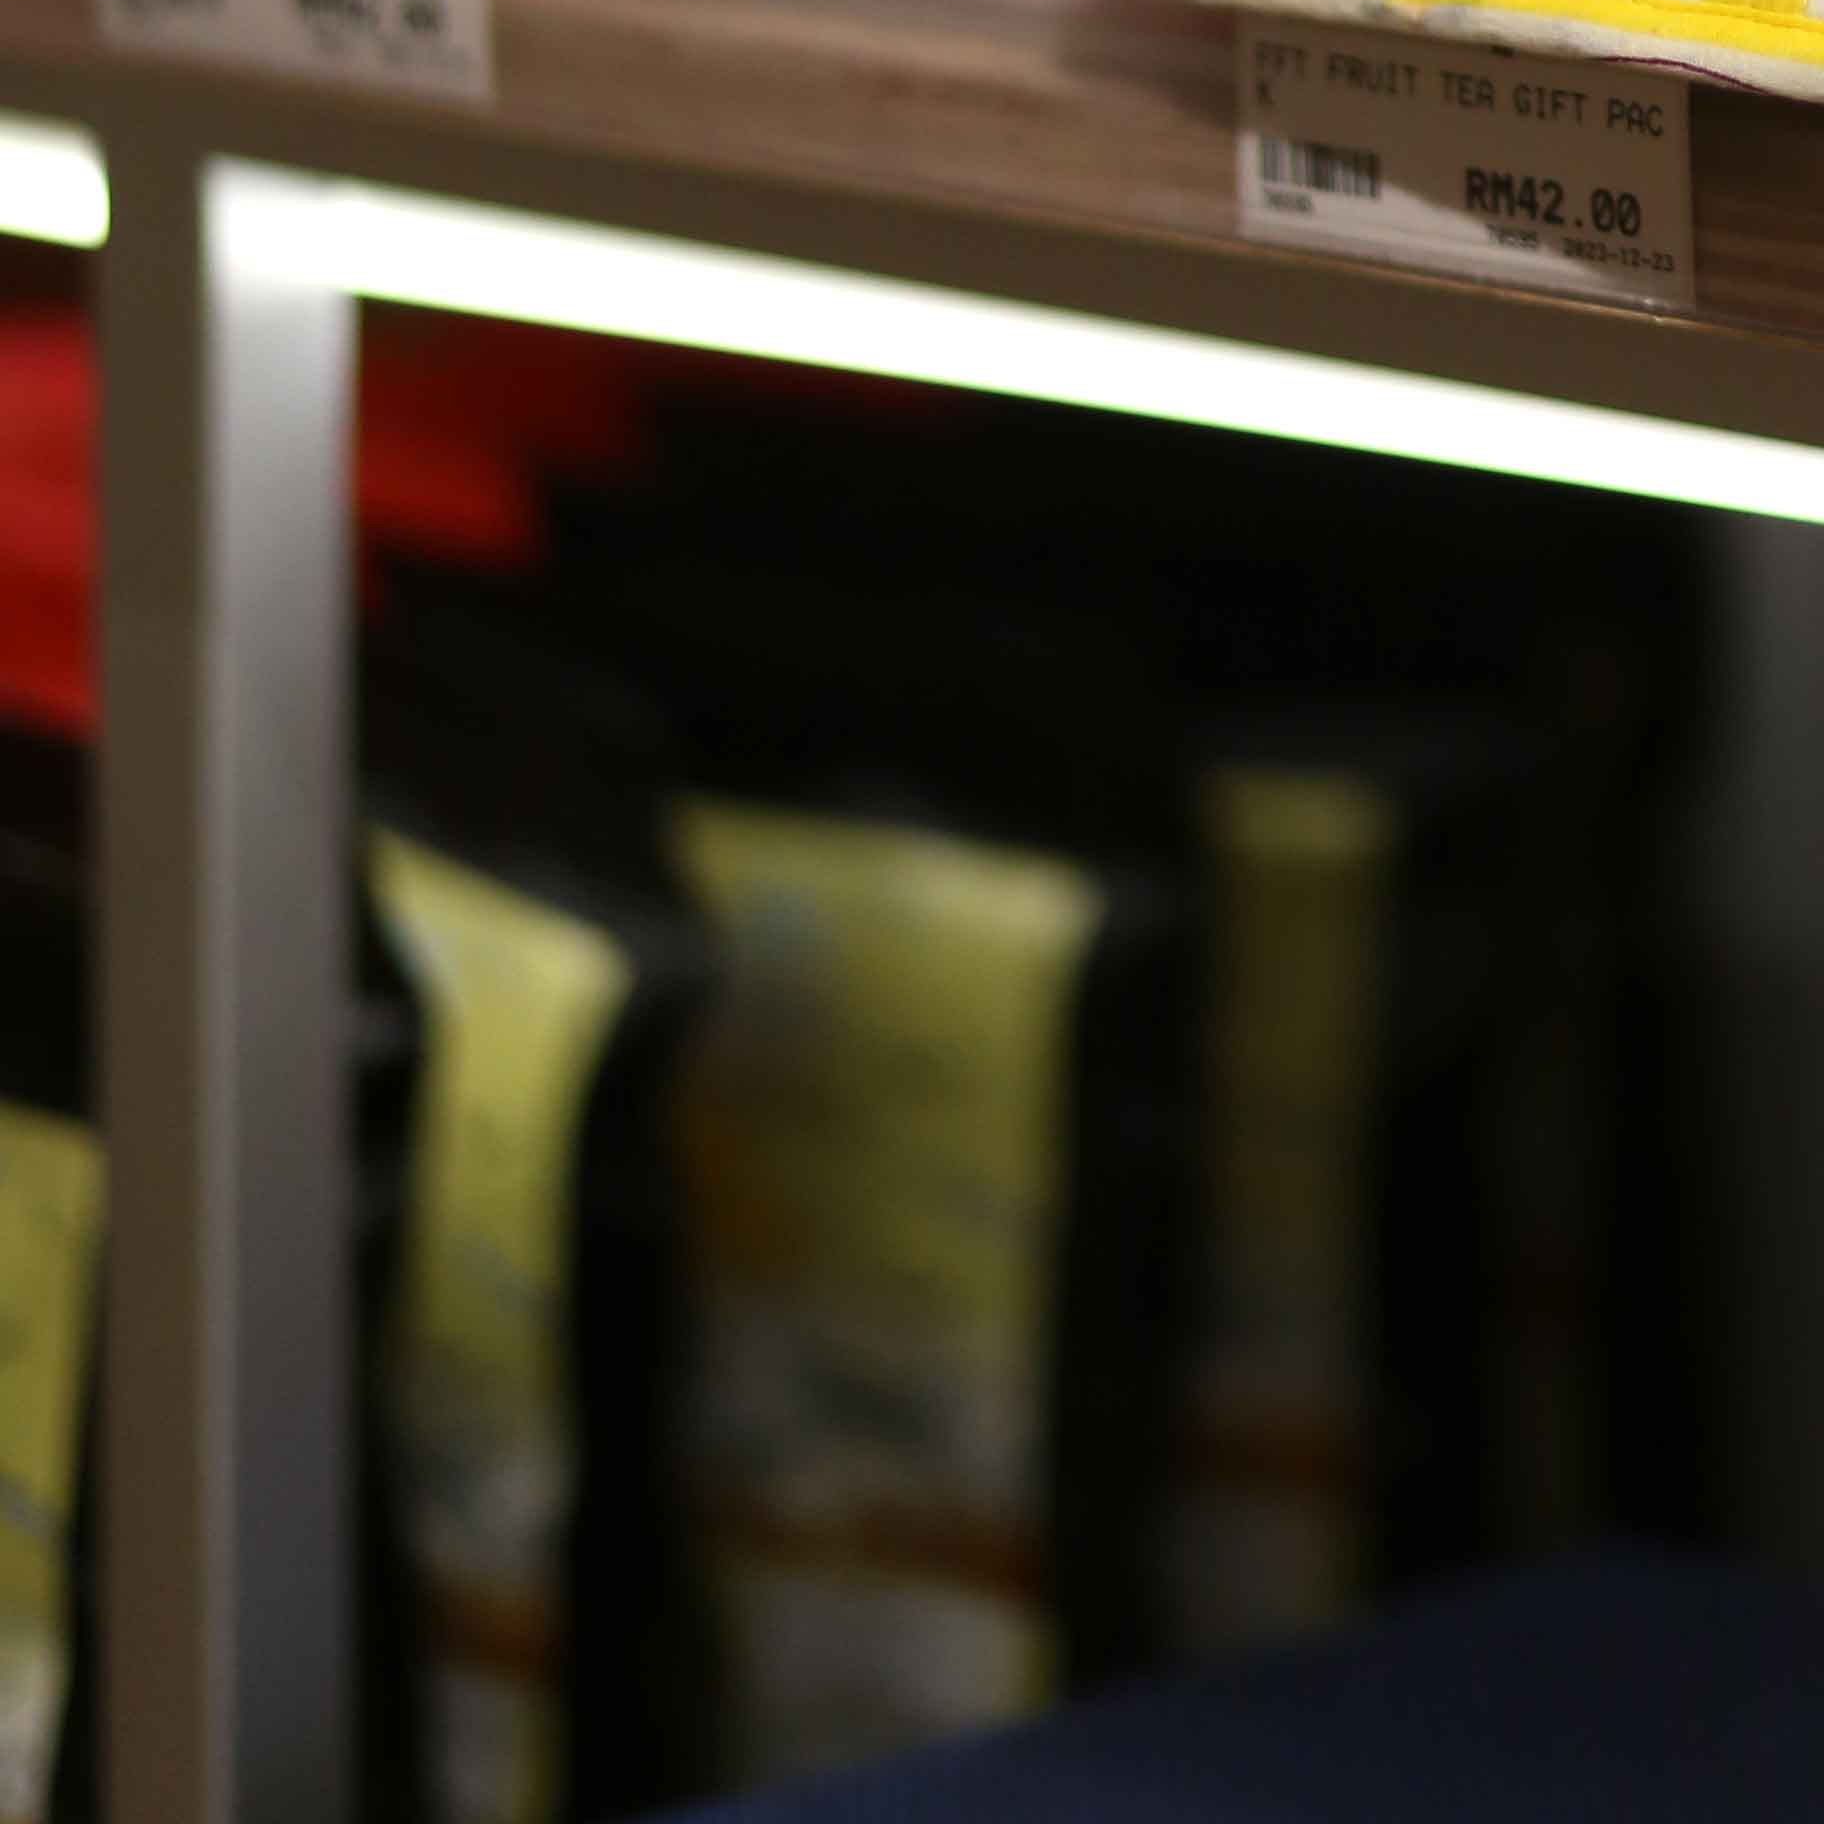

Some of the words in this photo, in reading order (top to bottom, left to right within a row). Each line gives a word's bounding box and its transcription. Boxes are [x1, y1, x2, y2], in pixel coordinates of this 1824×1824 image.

[1327, 51, 1421, 97] FRUIT
[1440, 70, 1496, 112] TEA
[1513, 83, 1588, 124] GIFT
[1606, 97, 1665, 137] PAC
[1464, 166, 1642, 238] RM42.00
